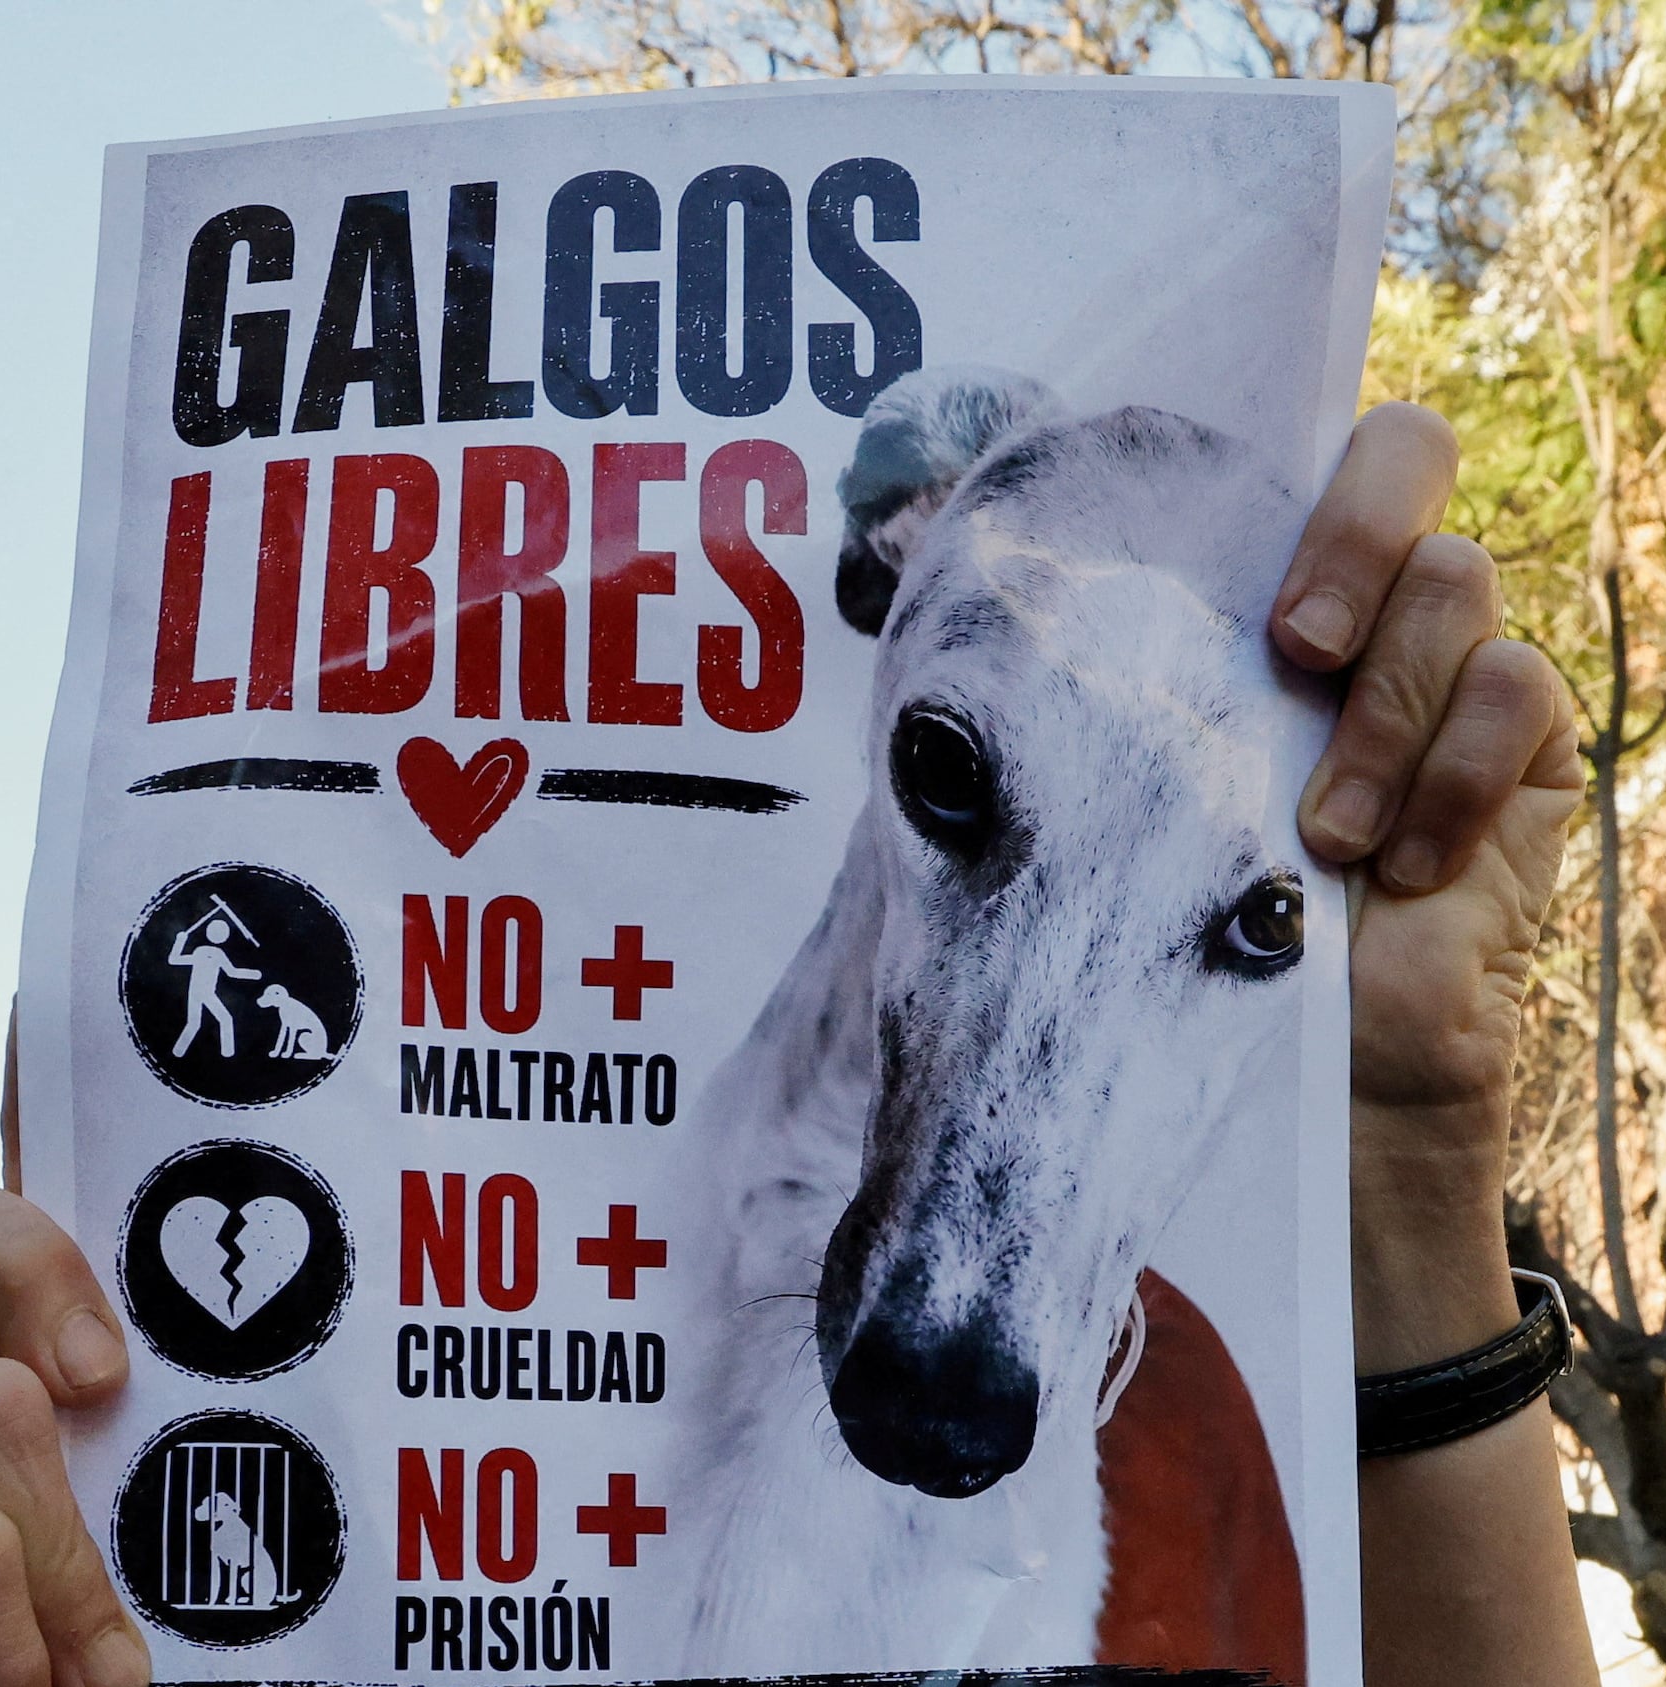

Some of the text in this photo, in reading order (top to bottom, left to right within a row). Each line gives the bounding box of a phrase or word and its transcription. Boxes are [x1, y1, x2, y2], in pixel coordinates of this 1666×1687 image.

[173, 157, 923, 447] GALGOS
[148, 440, 808, 733] LIBRES
[401, 894, 543, 1035] NO
[400, 1043, 677, 1127] MALTRATO
[399, 1170, 539, 1312] NO
[397, 1323, 666, 1404] CRUELDAD
[397, 1447, 538, 1584] NO
[394, 1579, 611, 1672] PRISIÓN
